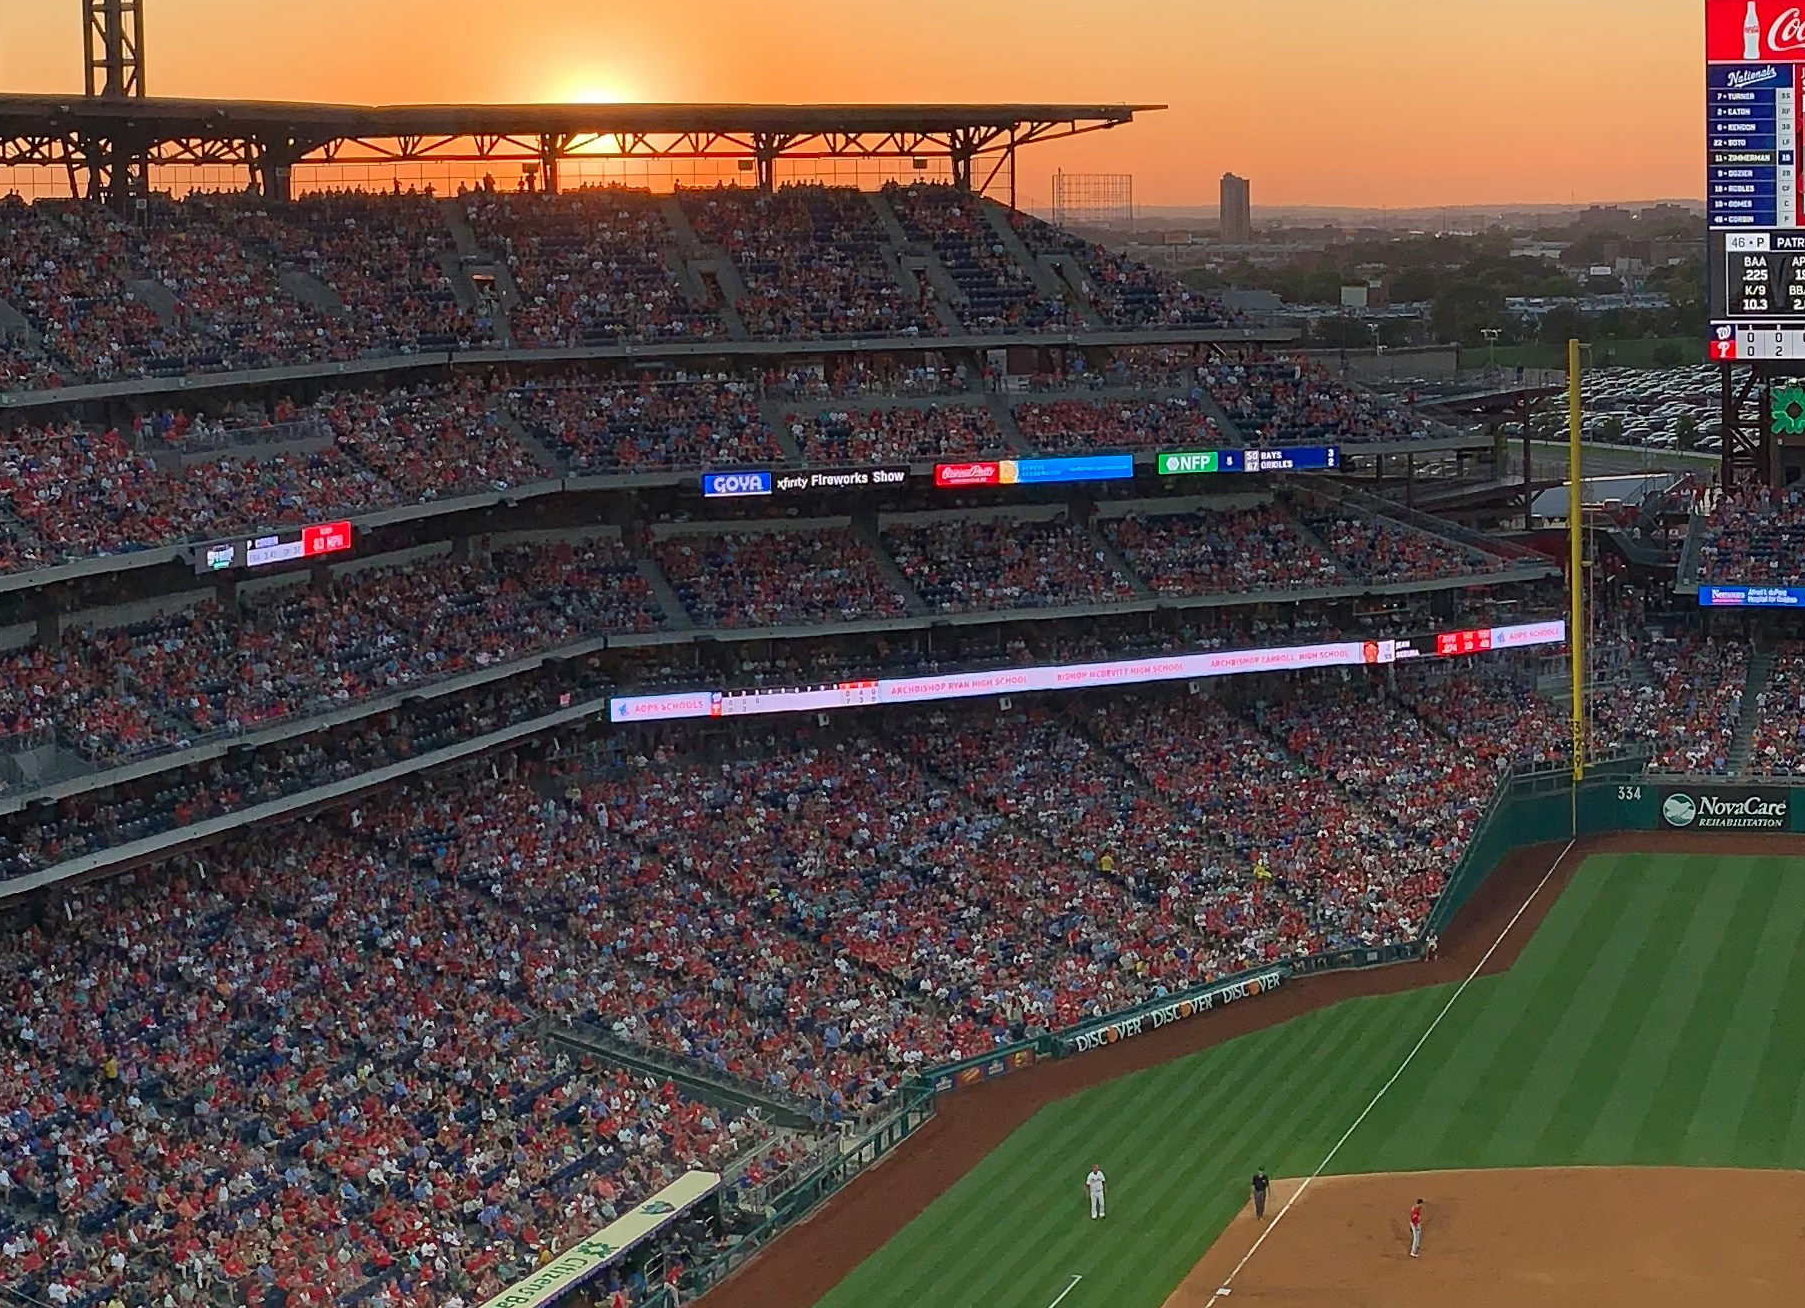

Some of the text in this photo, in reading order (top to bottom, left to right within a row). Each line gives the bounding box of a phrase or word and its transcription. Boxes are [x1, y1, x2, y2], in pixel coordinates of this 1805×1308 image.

[1727, 66, 1777, 88] Nationals
[1732, 237, 1764, 247] 46 P
[1745, 257, 1766, 266] BAA
[1743, 270, 1768, 280] .225
[1745, 286, 1766, 295] K/9
[1743, 300, 1768, 310] 10.3
[1260, 451, 1282, 460] RAYS
[1180, 456, 1211, 472] NFP
[1260, 459, 1293, 469] ORIOLES
[713, 476, 764, 493] GOYA
[776, 471, 904, 490] xfinity Fireworks Show
[1618, 787, 1641, 800] 334
[1698, 796, 1786, 817] NovaCare
[1699, 818, 1783, 827] REHABILITATION
[527, 1255, 589, 1298] Citizens
